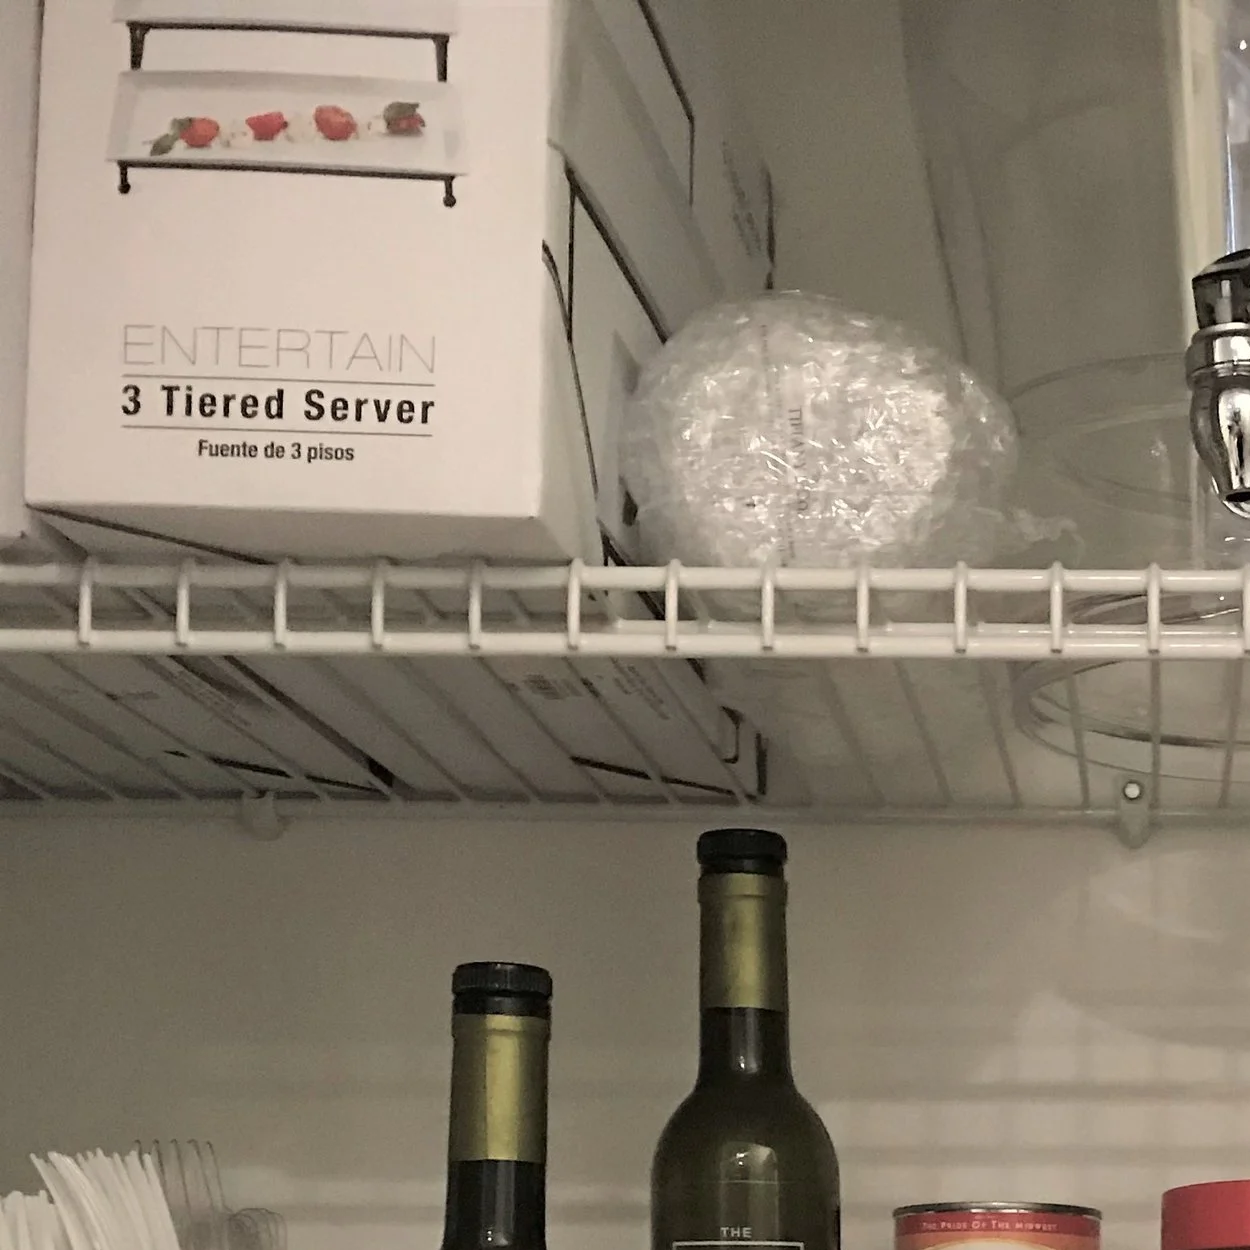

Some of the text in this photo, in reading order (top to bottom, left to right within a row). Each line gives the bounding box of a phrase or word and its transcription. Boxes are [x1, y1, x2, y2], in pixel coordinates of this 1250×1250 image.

[123, 324, 435, 373] ENTERTAIN
[121, 384, 435, 424] 3 Tiered Server
[198, 439, 355, 463] Fuente de 3 pisos
[720, 1226, 752, 1238] THE
